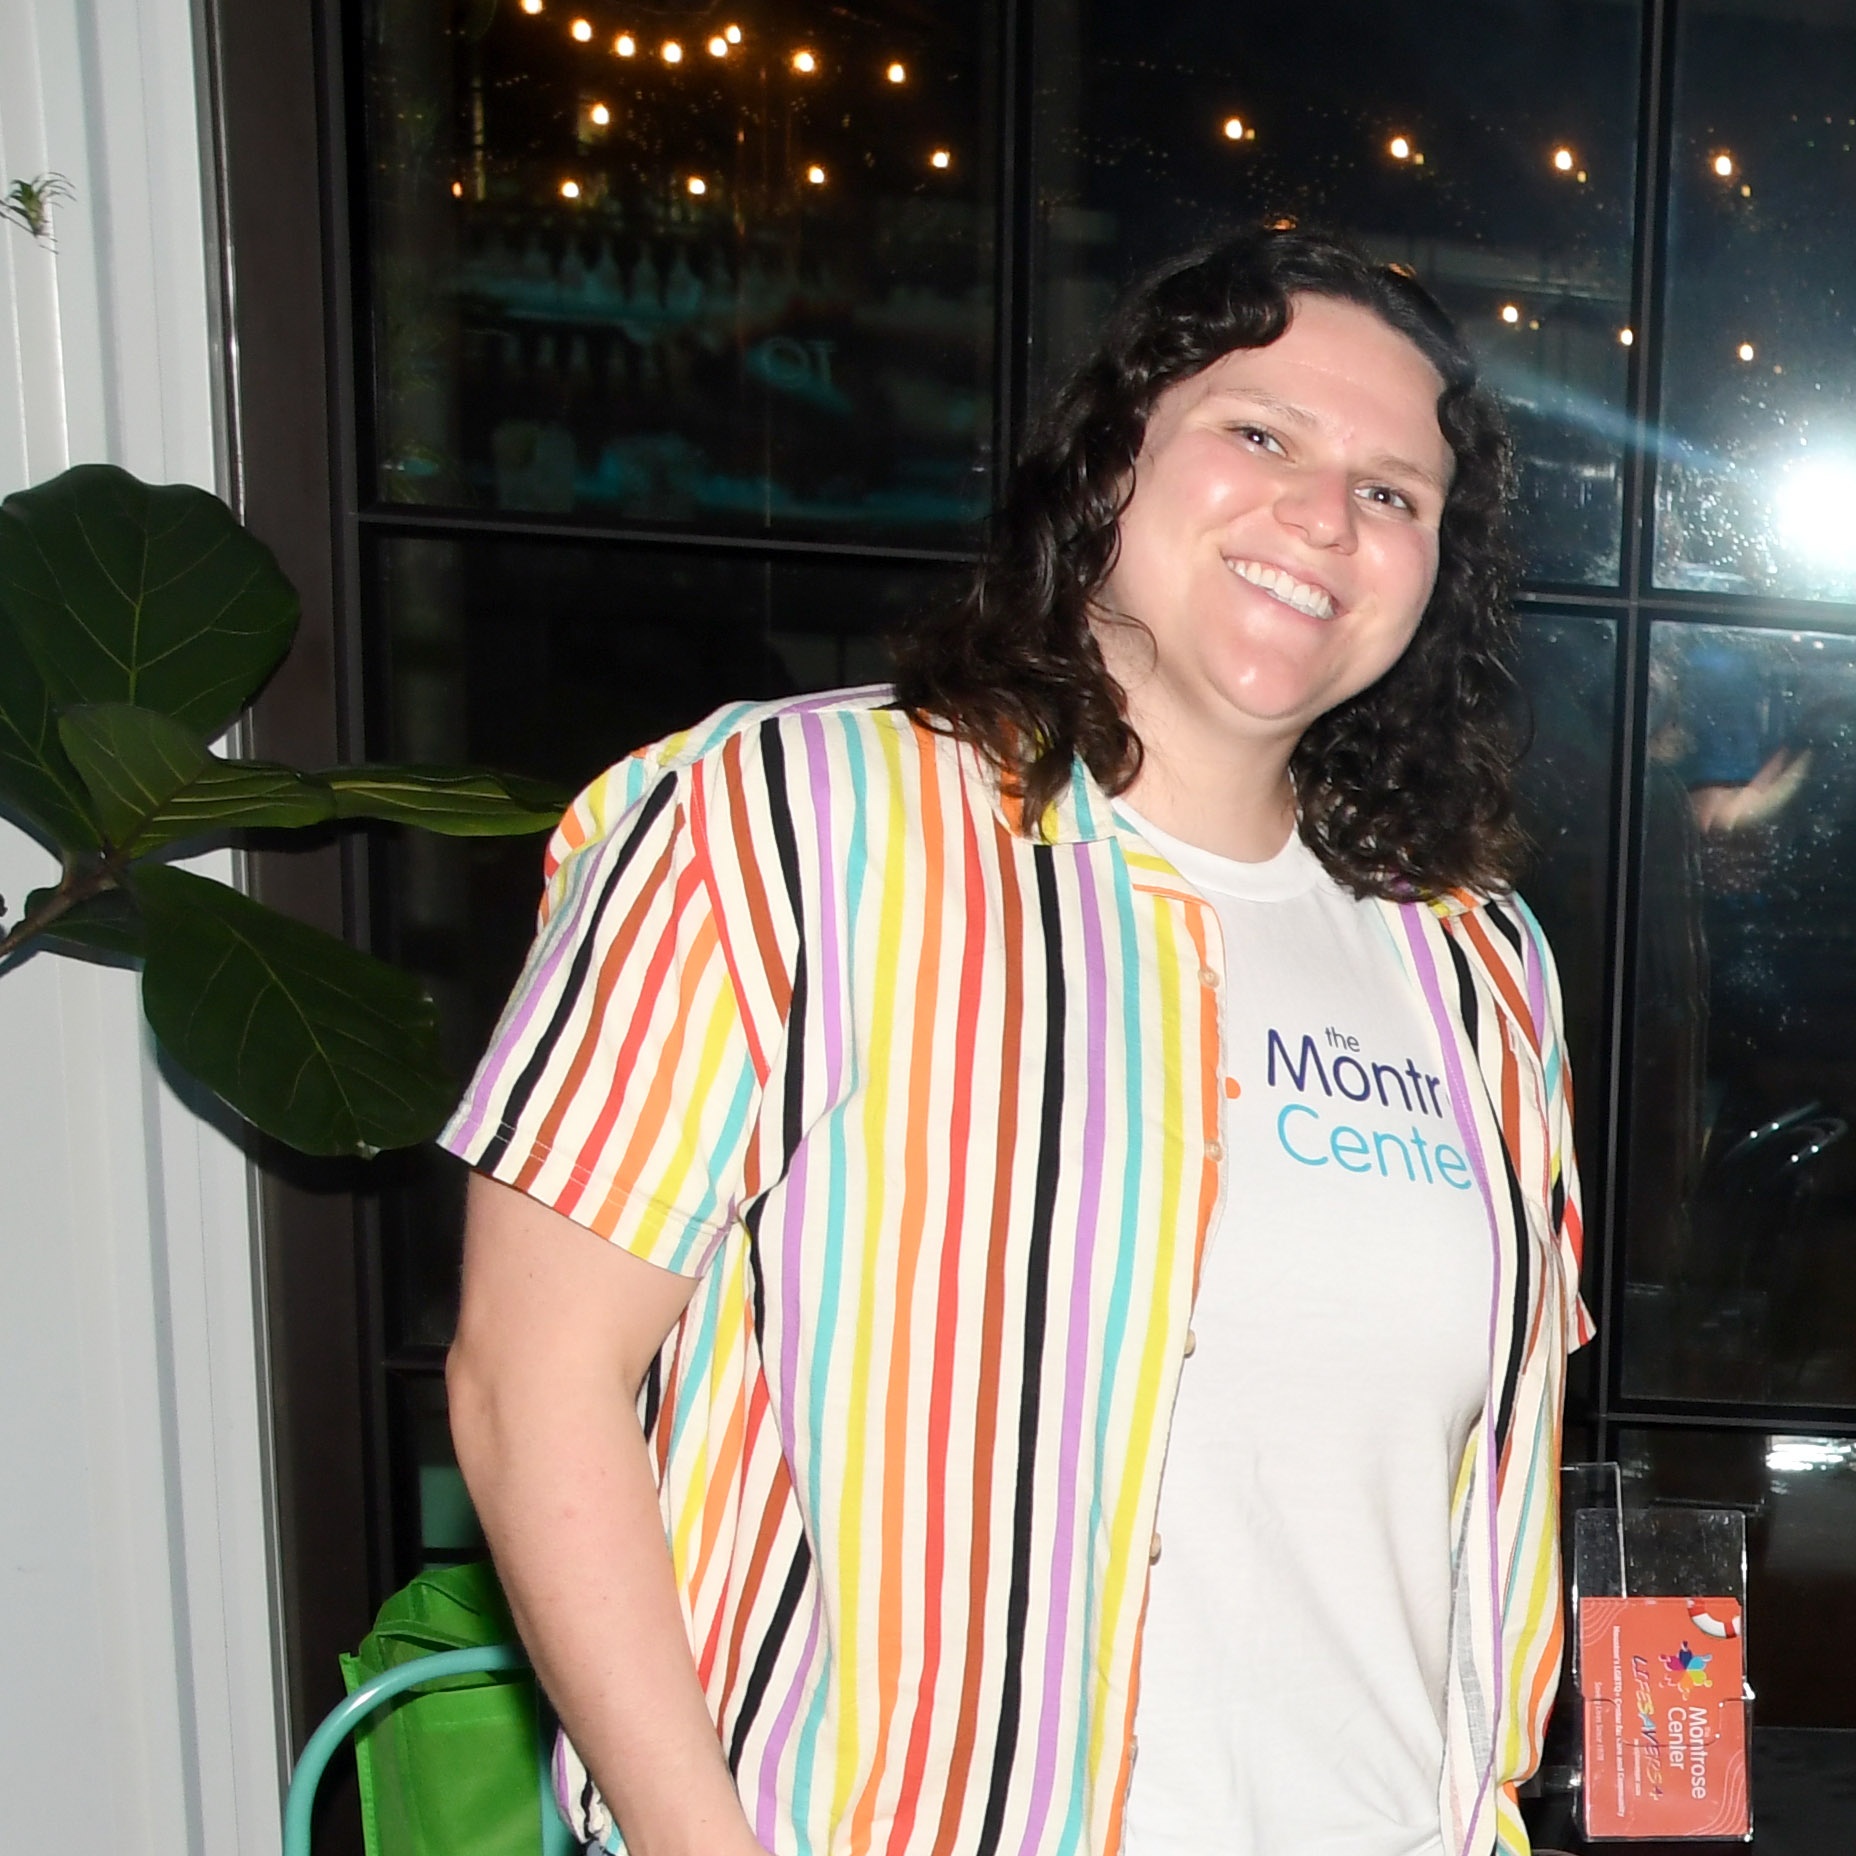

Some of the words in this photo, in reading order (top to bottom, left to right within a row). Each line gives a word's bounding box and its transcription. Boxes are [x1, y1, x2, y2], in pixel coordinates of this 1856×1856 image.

[1267, 1028, 1445, 1119] Montr
[1325, 1026, 1360, 1052] the
[1667, 1706, 1687, 1770] Center
[1688, 1706, 1708, 1799] Montrose
